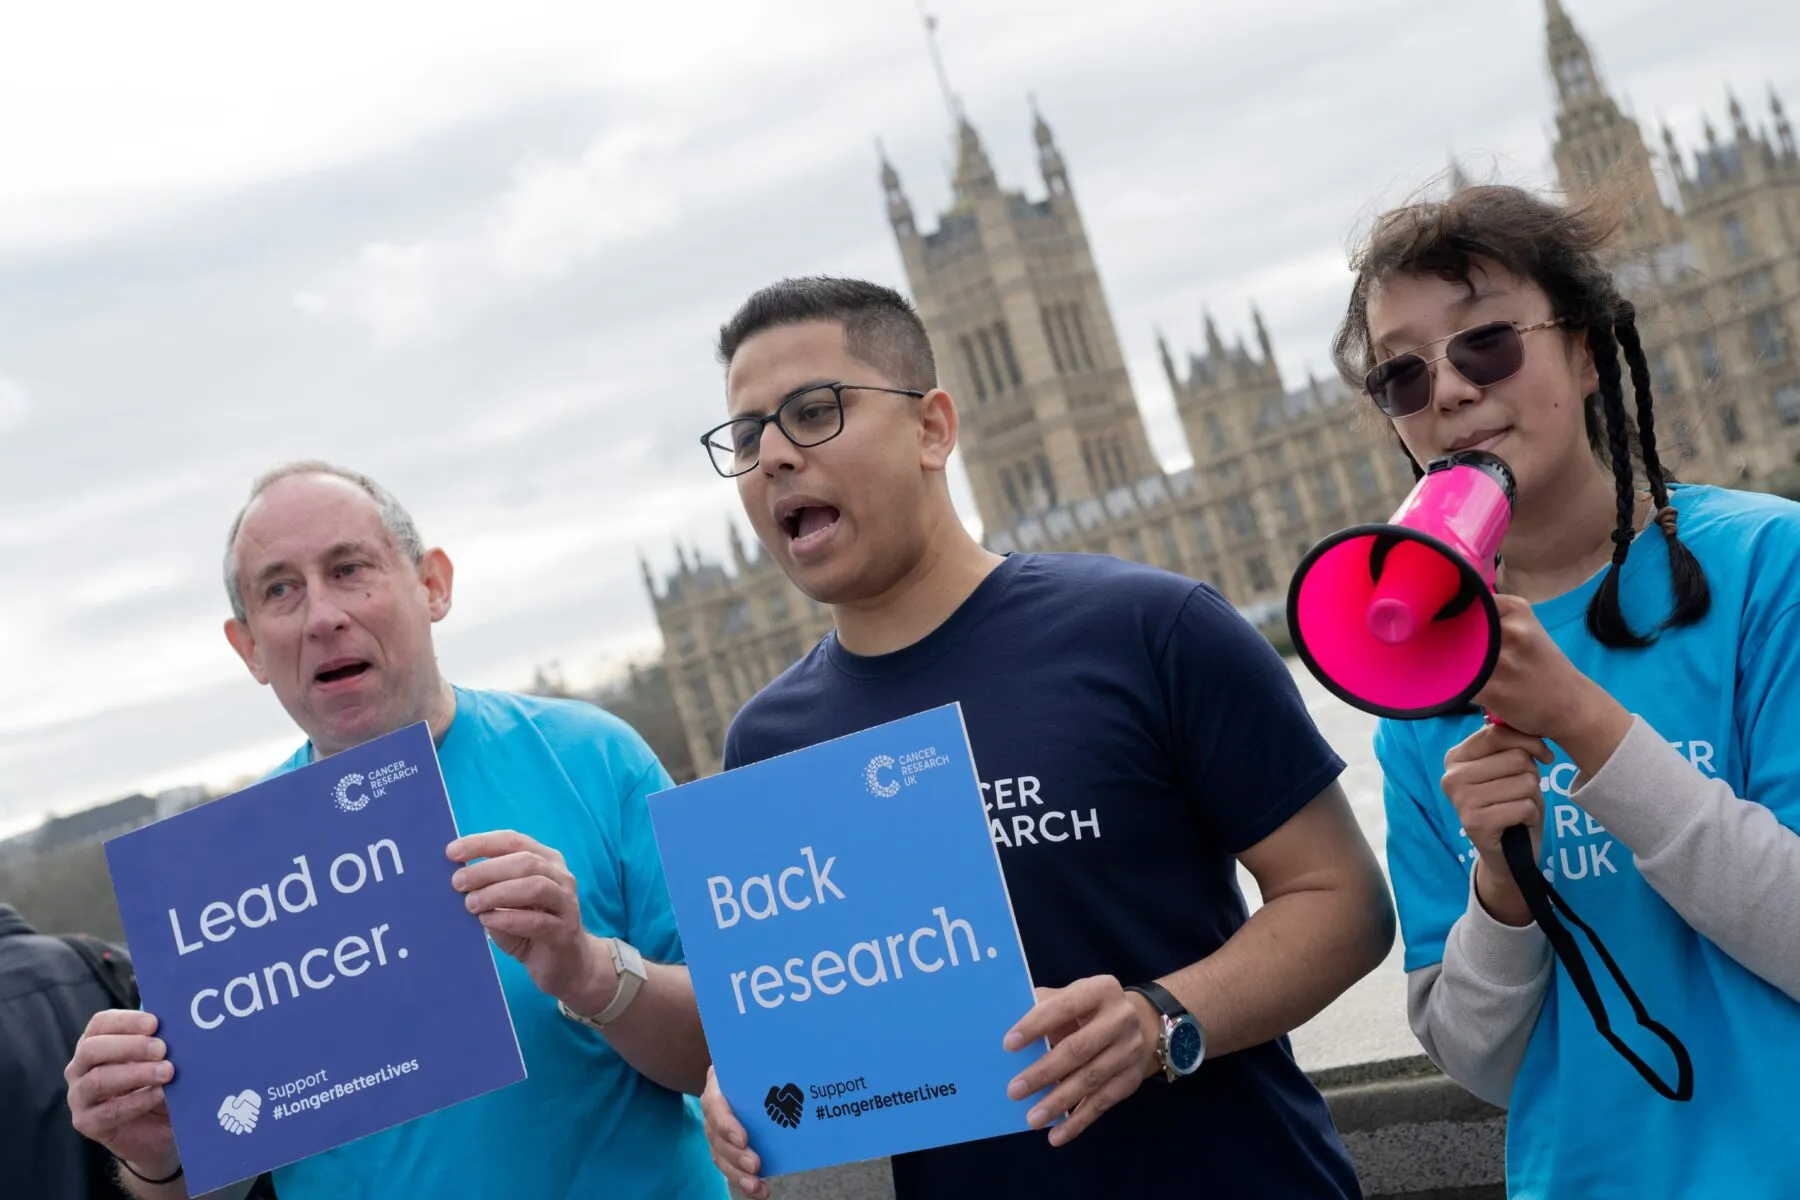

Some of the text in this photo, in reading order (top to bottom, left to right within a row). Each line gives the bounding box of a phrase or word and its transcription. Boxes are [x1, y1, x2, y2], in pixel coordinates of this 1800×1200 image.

[368, 760, 406, 780] CANCER
[899, 747, 936, 765] CANCER
[901, 755, 950, 776] RESEARCH
[370, 764, 418, 789] RESEARCH
[373, 787, 387, 798] UK
[903, 776, 918, 786] UK
[1559, 841, 1618, 880] UK
[168, 838, 404, 956] Lead on
[707, 846, 846, 930] Back
[190, 922, 408, 1030] cancer.
[730, 906, 998, 1015] research.
[267, 1068, 328, 1101] Support
[273, 1057, 419, 1121] #LongerBetterLives
[809, 1076, 868, 1100] Support
[816, 1081, 957, 1121] #LongerBetterLives
